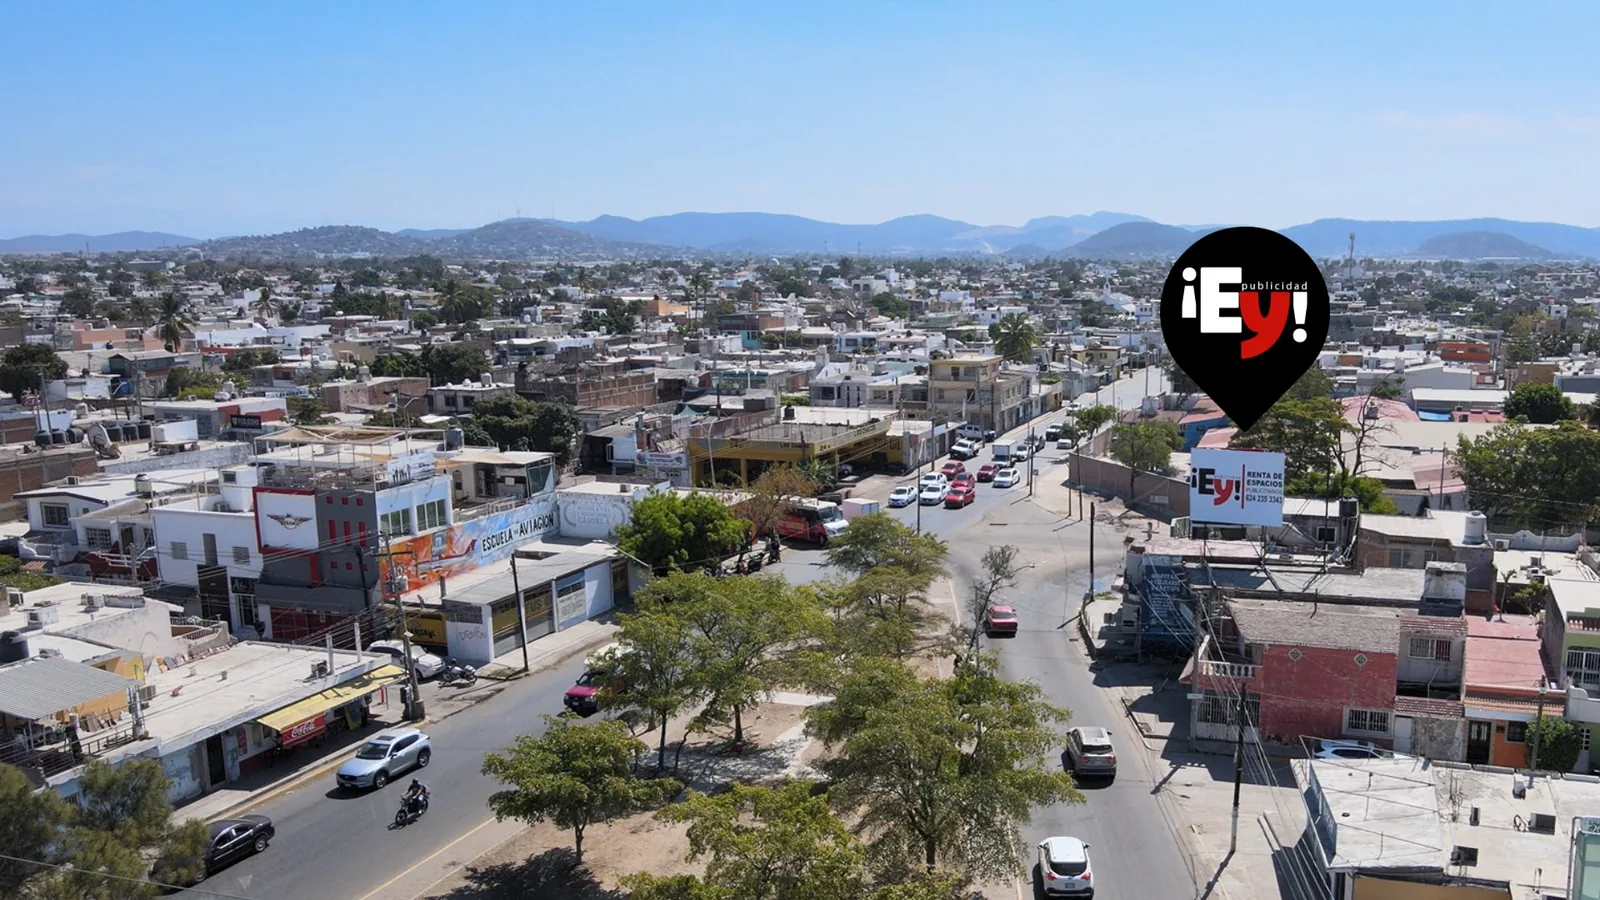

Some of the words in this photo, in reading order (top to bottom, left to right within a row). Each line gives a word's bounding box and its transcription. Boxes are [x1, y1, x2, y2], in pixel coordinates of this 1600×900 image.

[1246, 471, 1271, 479] RENTA
[1273, 472, 1283, 480] DE
[1246, 479, 1283, 488] ESPACIOS
[1246, 487, 1282, 495] PUBLICITARIOS
[1257, 495, 1268, 503] 235
[482, 528, 514, 552] ESCUELA
[519, 513, 554, 537] AVIACION
